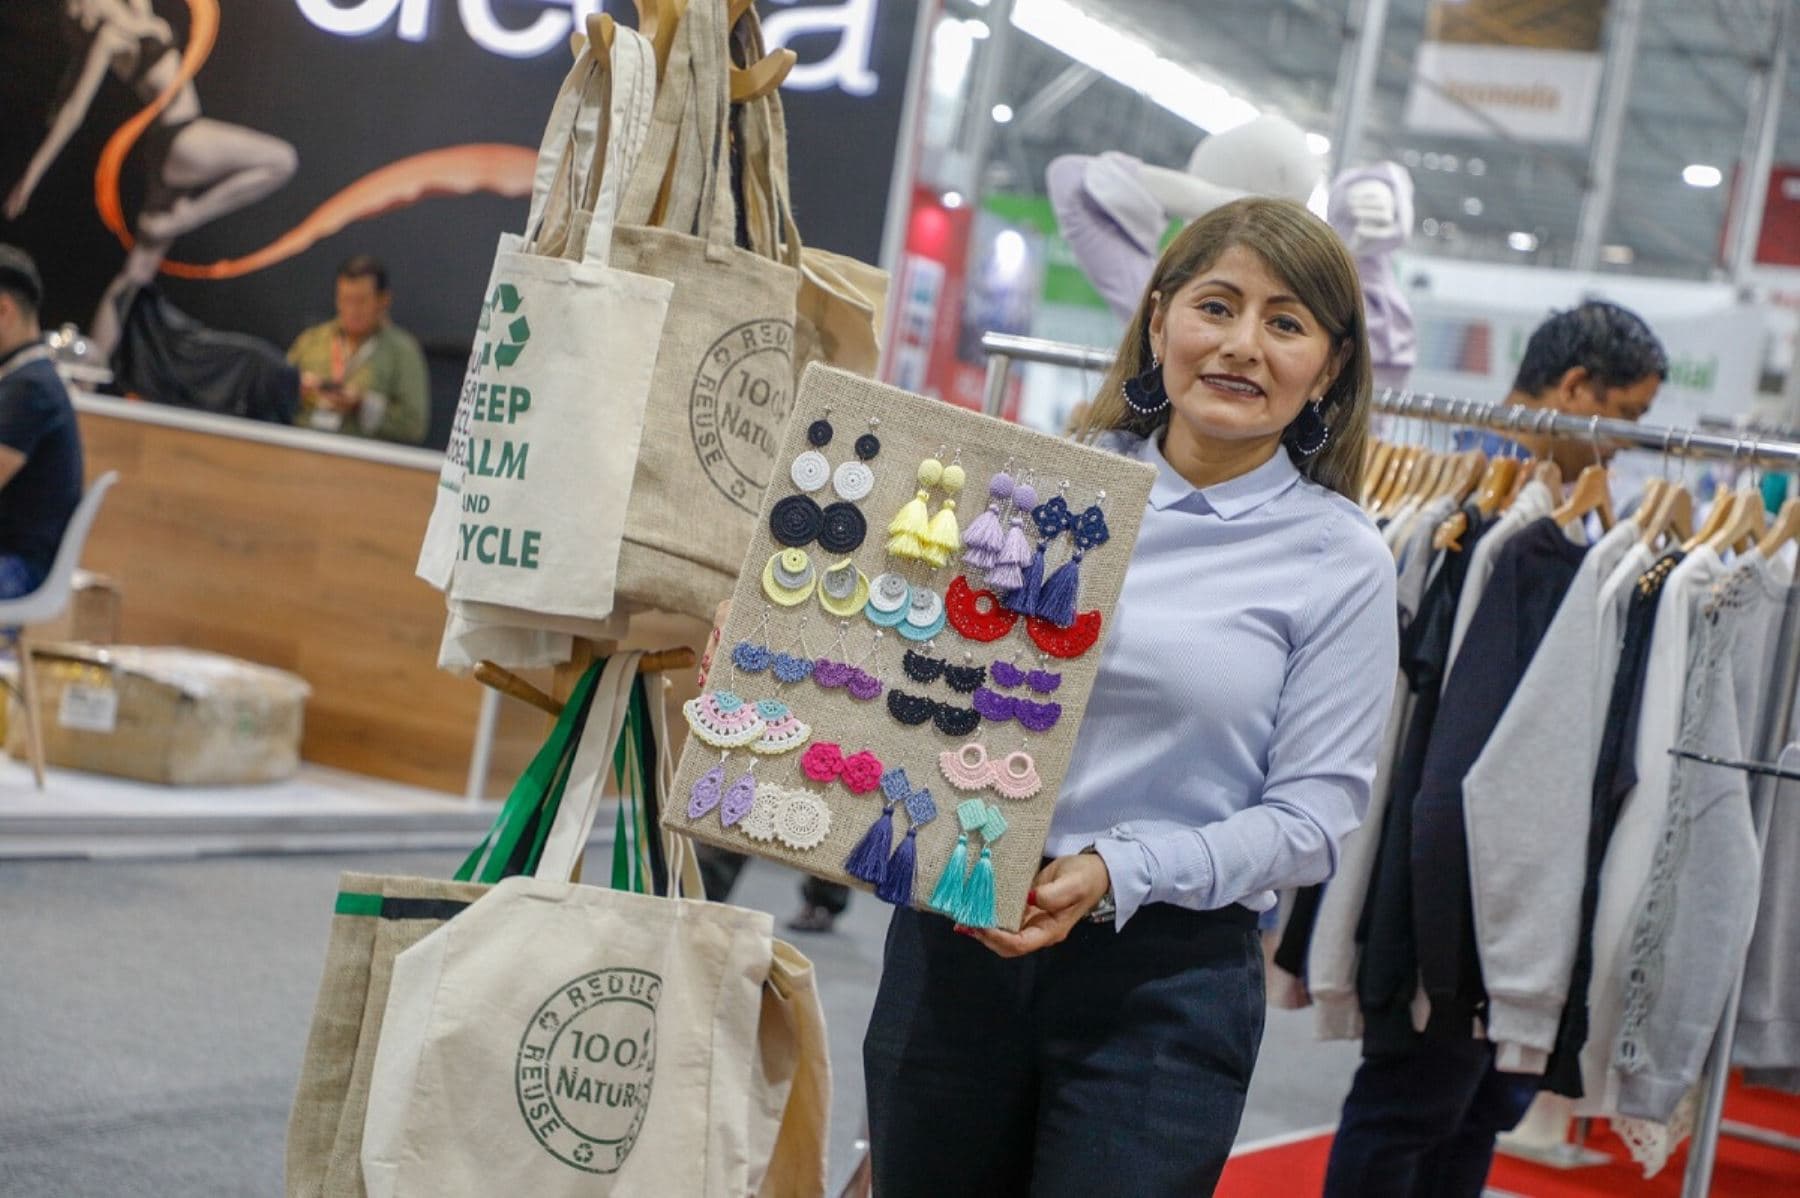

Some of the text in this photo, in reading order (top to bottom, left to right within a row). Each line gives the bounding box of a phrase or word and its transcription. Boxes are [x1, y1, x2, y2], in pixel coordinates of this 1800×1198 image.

[696, 374, 724, 467] REUSE
[456, 523, 542, 569] YCLE
[521, 1044, 561, 1138] REUSE
